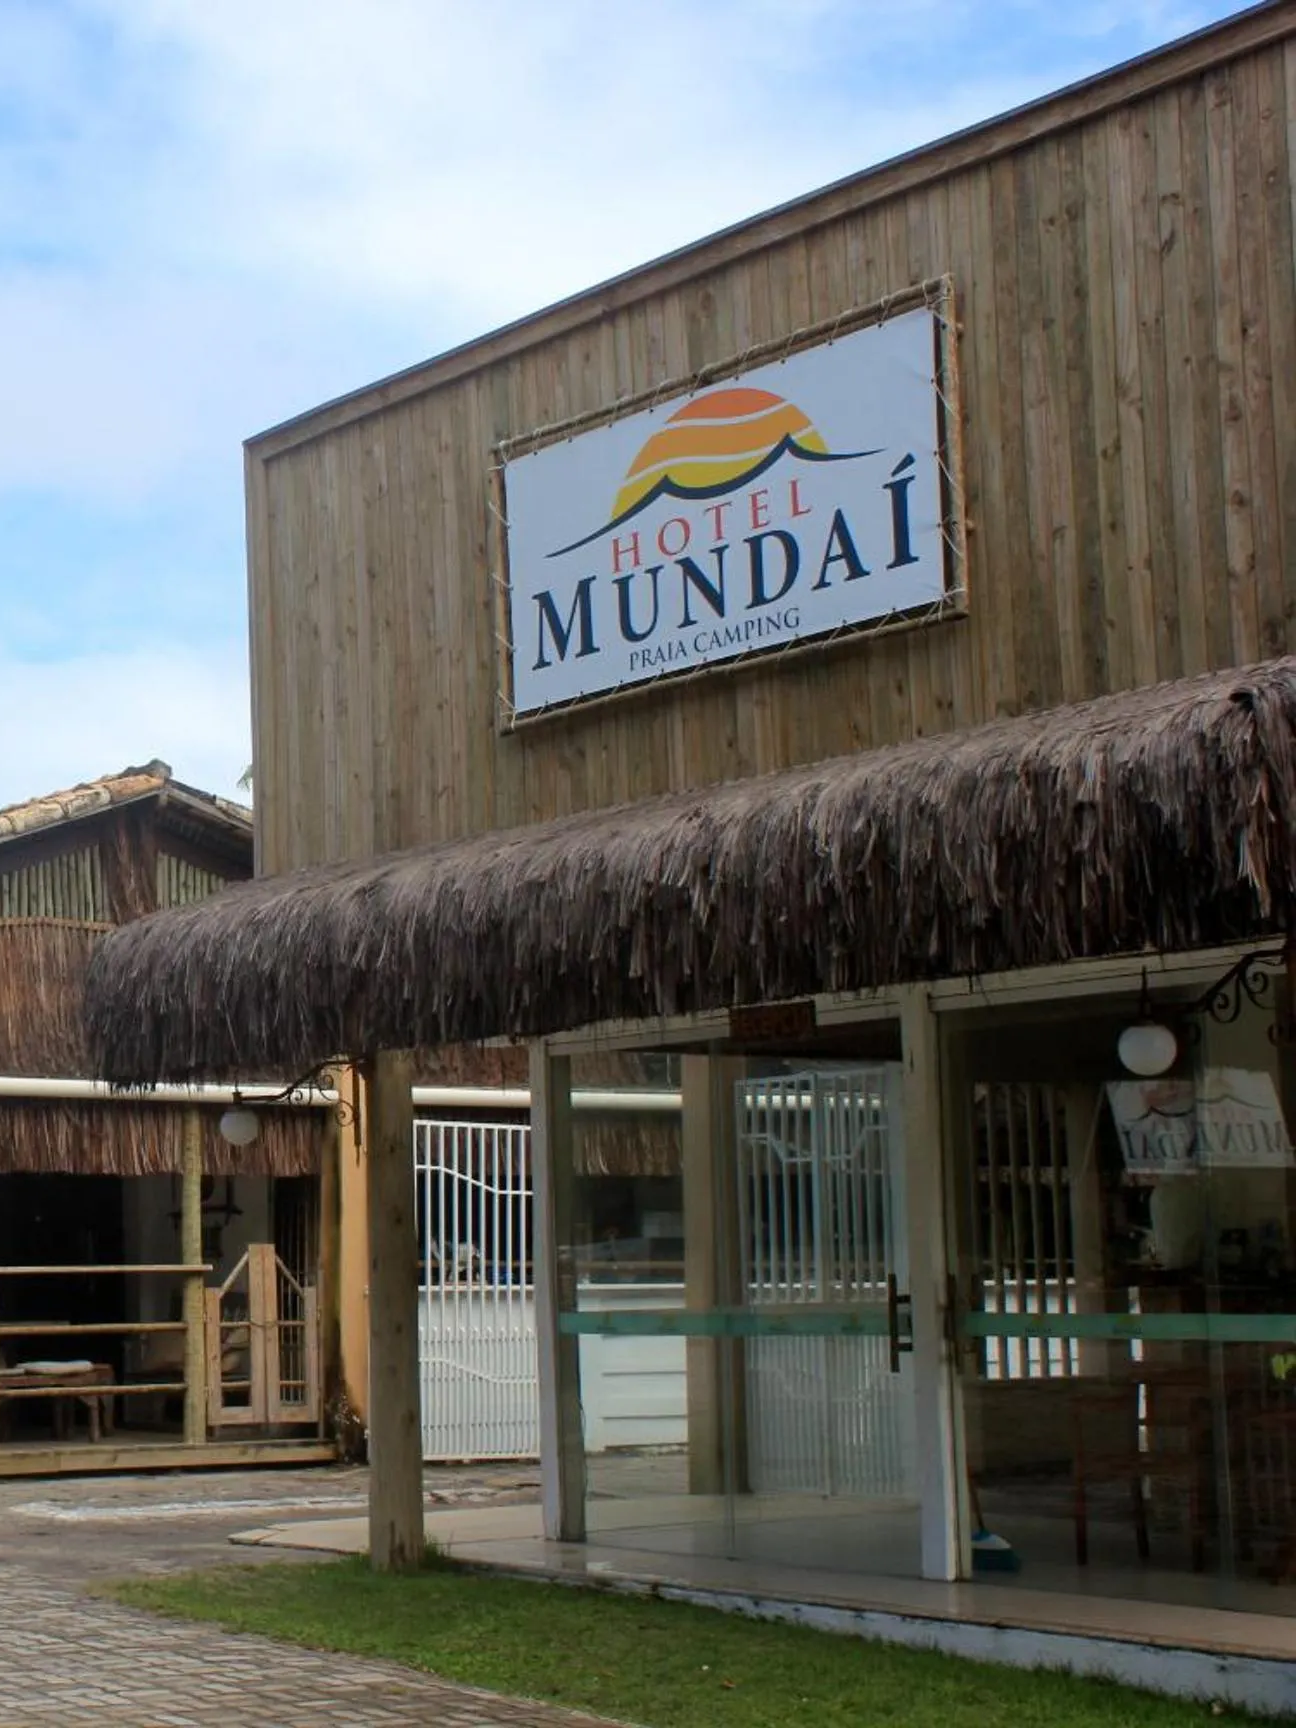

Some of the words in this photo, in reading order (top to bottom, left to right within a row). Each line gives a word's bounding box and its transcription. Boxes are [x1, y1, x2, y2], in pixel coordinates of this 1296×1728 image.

[531, 453, 920, 672] MUNDAÍ
[611, 478, 812, 574] HOTEL
[629, 640, 689, 672] PRAIA
[693, 607, 801, 654] CAMPING
